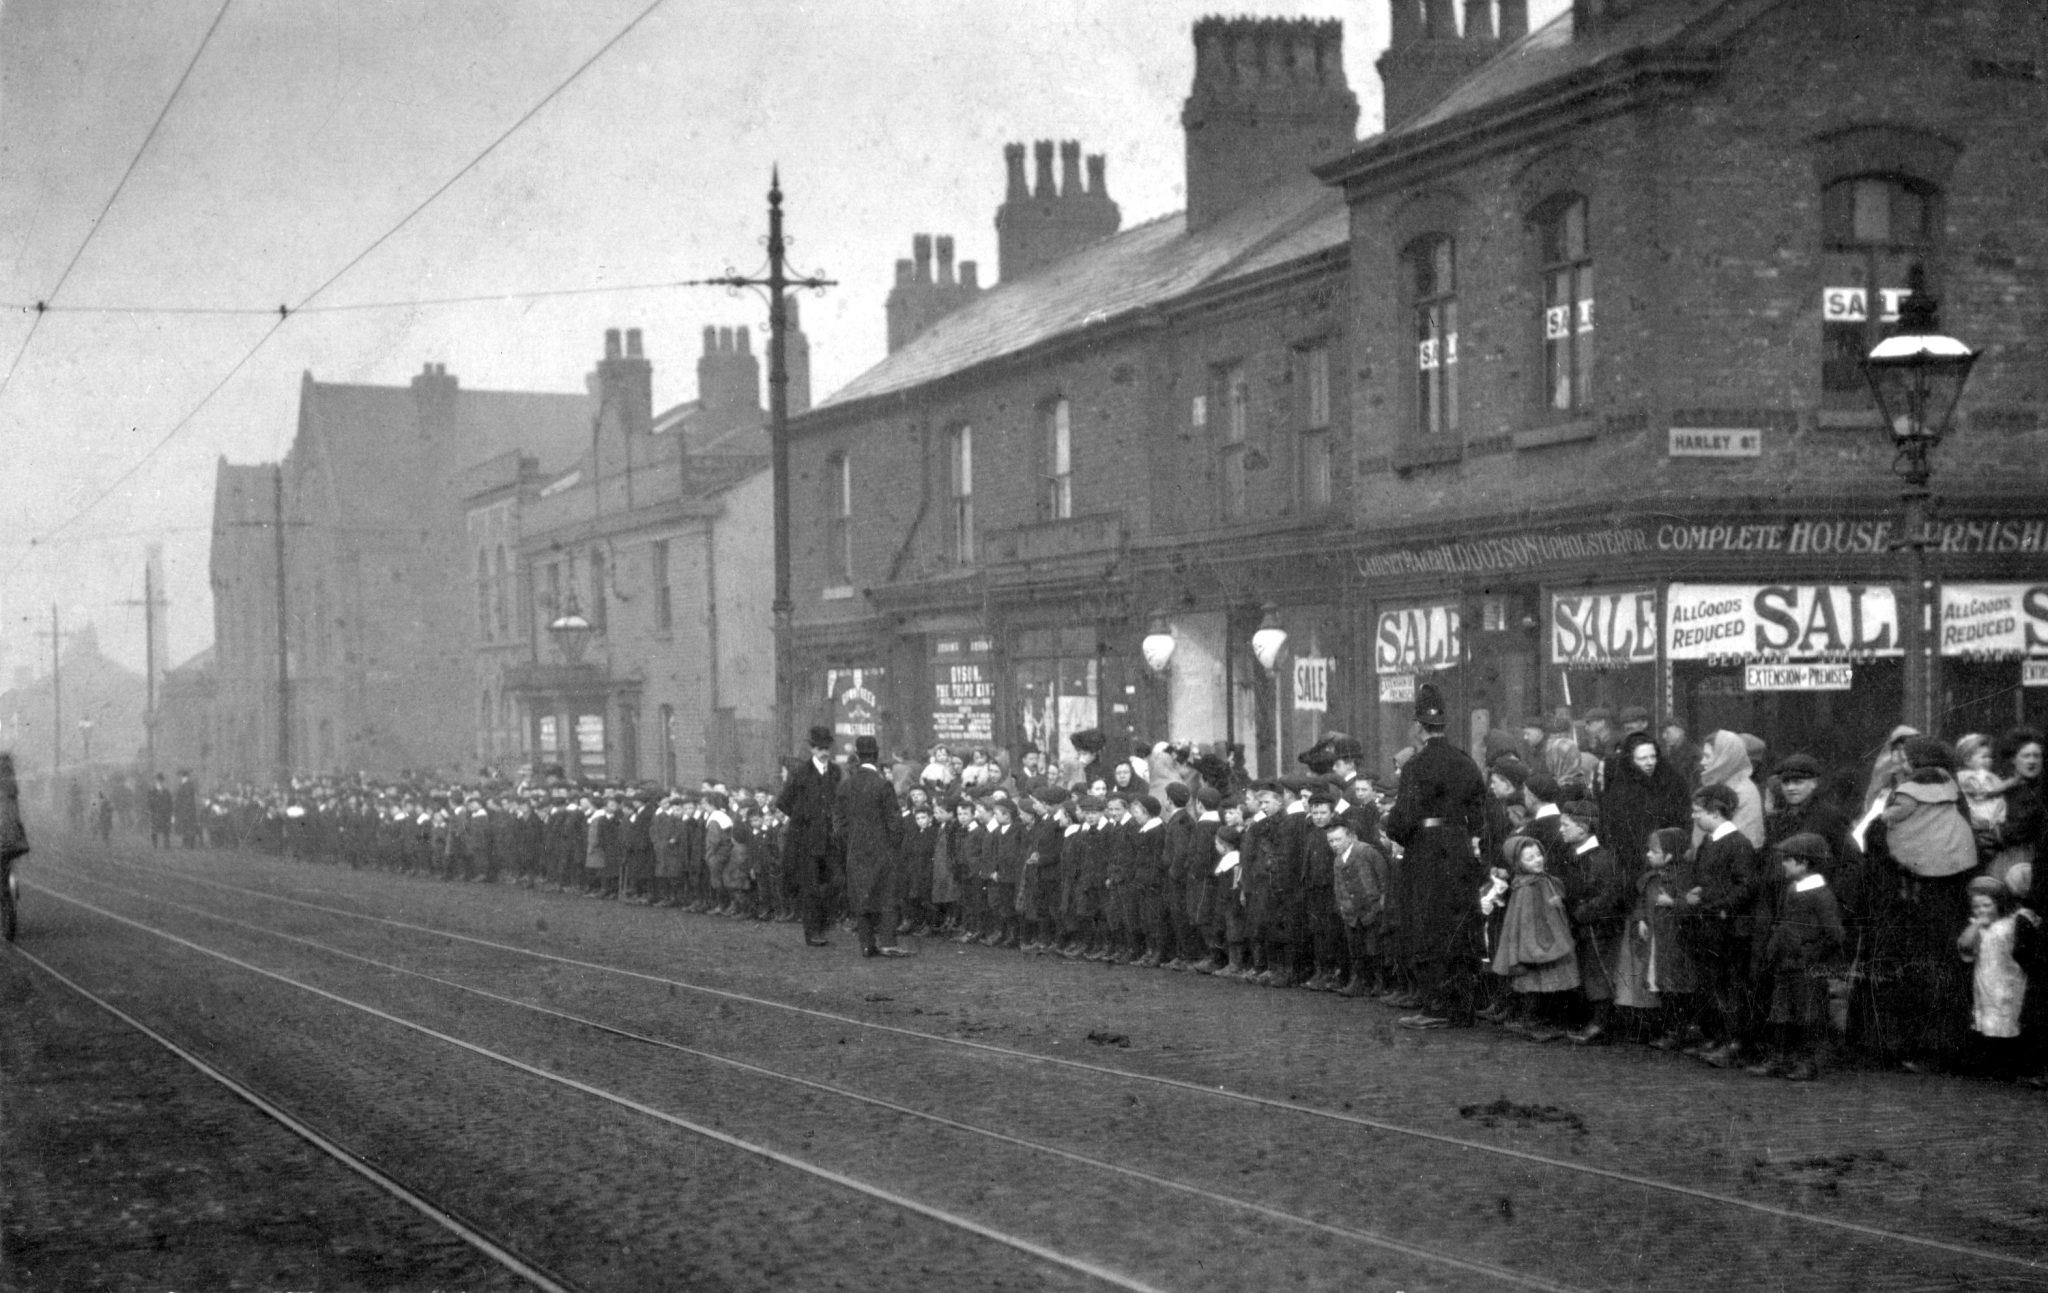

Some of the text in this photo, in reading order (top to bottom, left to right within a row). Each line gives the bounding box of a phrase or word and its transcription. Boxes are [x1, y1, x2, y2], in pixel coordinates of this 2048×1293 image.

[1675, 435, 1731, 450] HARLEY
[1657, 524, 1785, 550] COMPLETE
[1788, 520, 1893, 553] HOUSE
[1379, 607, 1461, 668] SALE
[1554, 594, 1656, 657] SALE
[1672, 618, 1746, 650] REDUCED
[1943, 617, 2016, 647] REDUCED
[1297, 665, 1324, 702] SALE
[1749, 668, 1800, 686] EXTENSION
[1808, 667, 1851, 685] PREMISES
